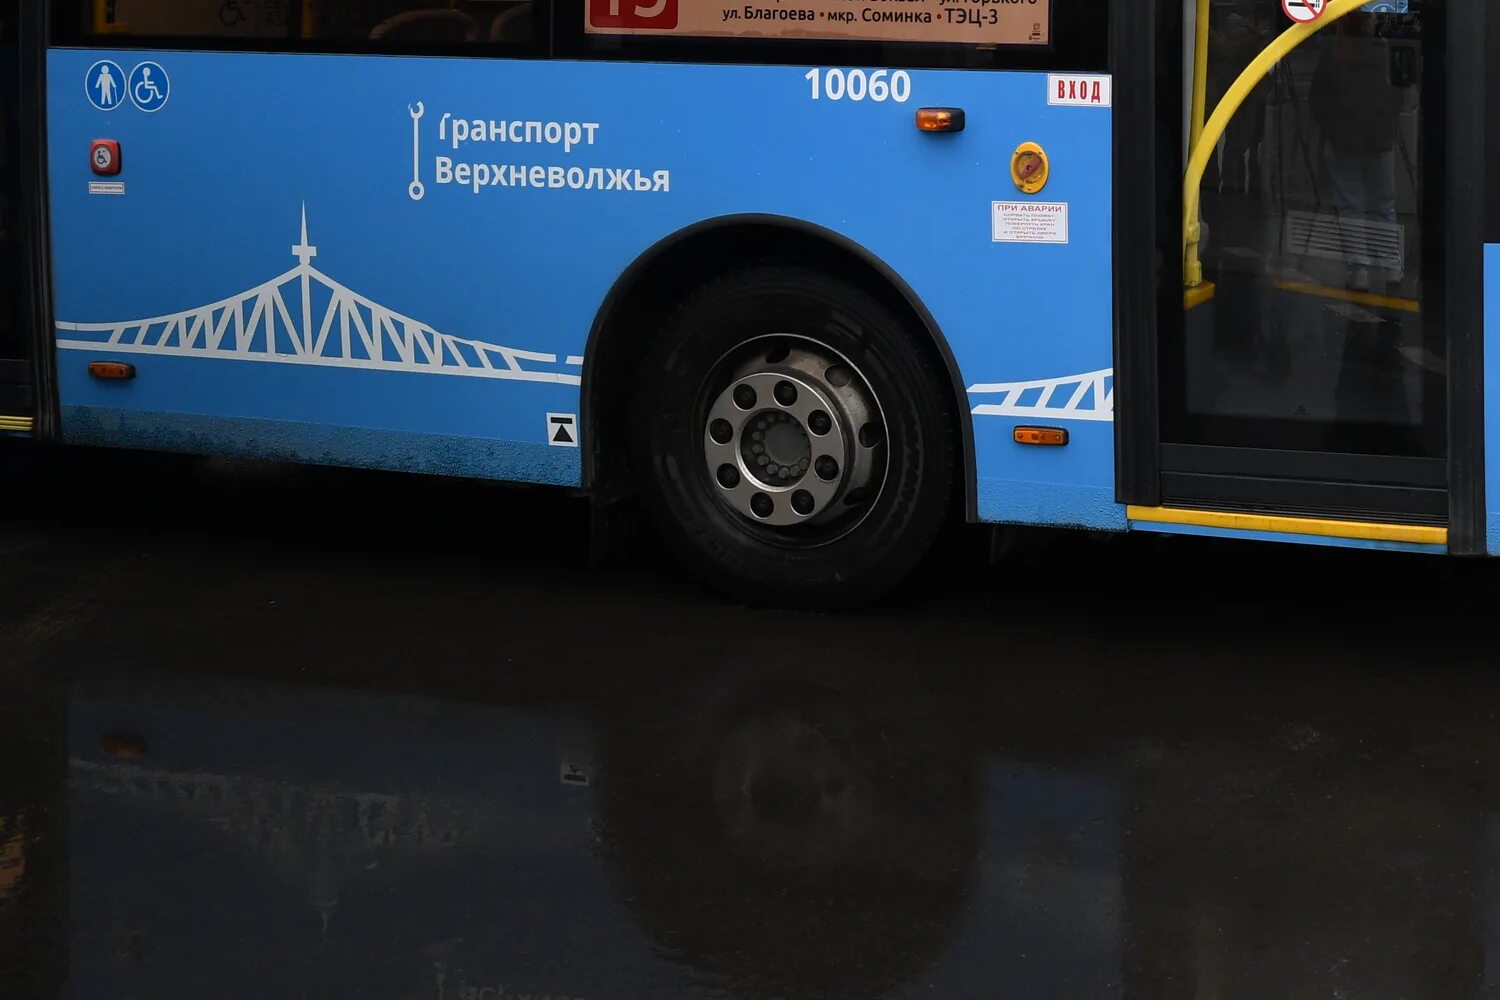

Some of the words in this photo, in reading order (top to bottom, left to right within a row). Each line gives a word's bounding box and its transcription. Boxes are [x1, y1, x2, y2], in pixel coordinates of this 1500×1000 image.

[722, 9, 742, 22] ул.
[744, 5, 815, 21] Благоева
[827, 11, 858, 25] мкр.
[861, 7, 932, 24] Соминка
[944, 7, 998, 28] ТЭЦ-3
[805, 67, 912, 103] 10060
[1057, 80, 1101, 103] ВХОД
[435, 155, 671, 194] Верхневолжья
